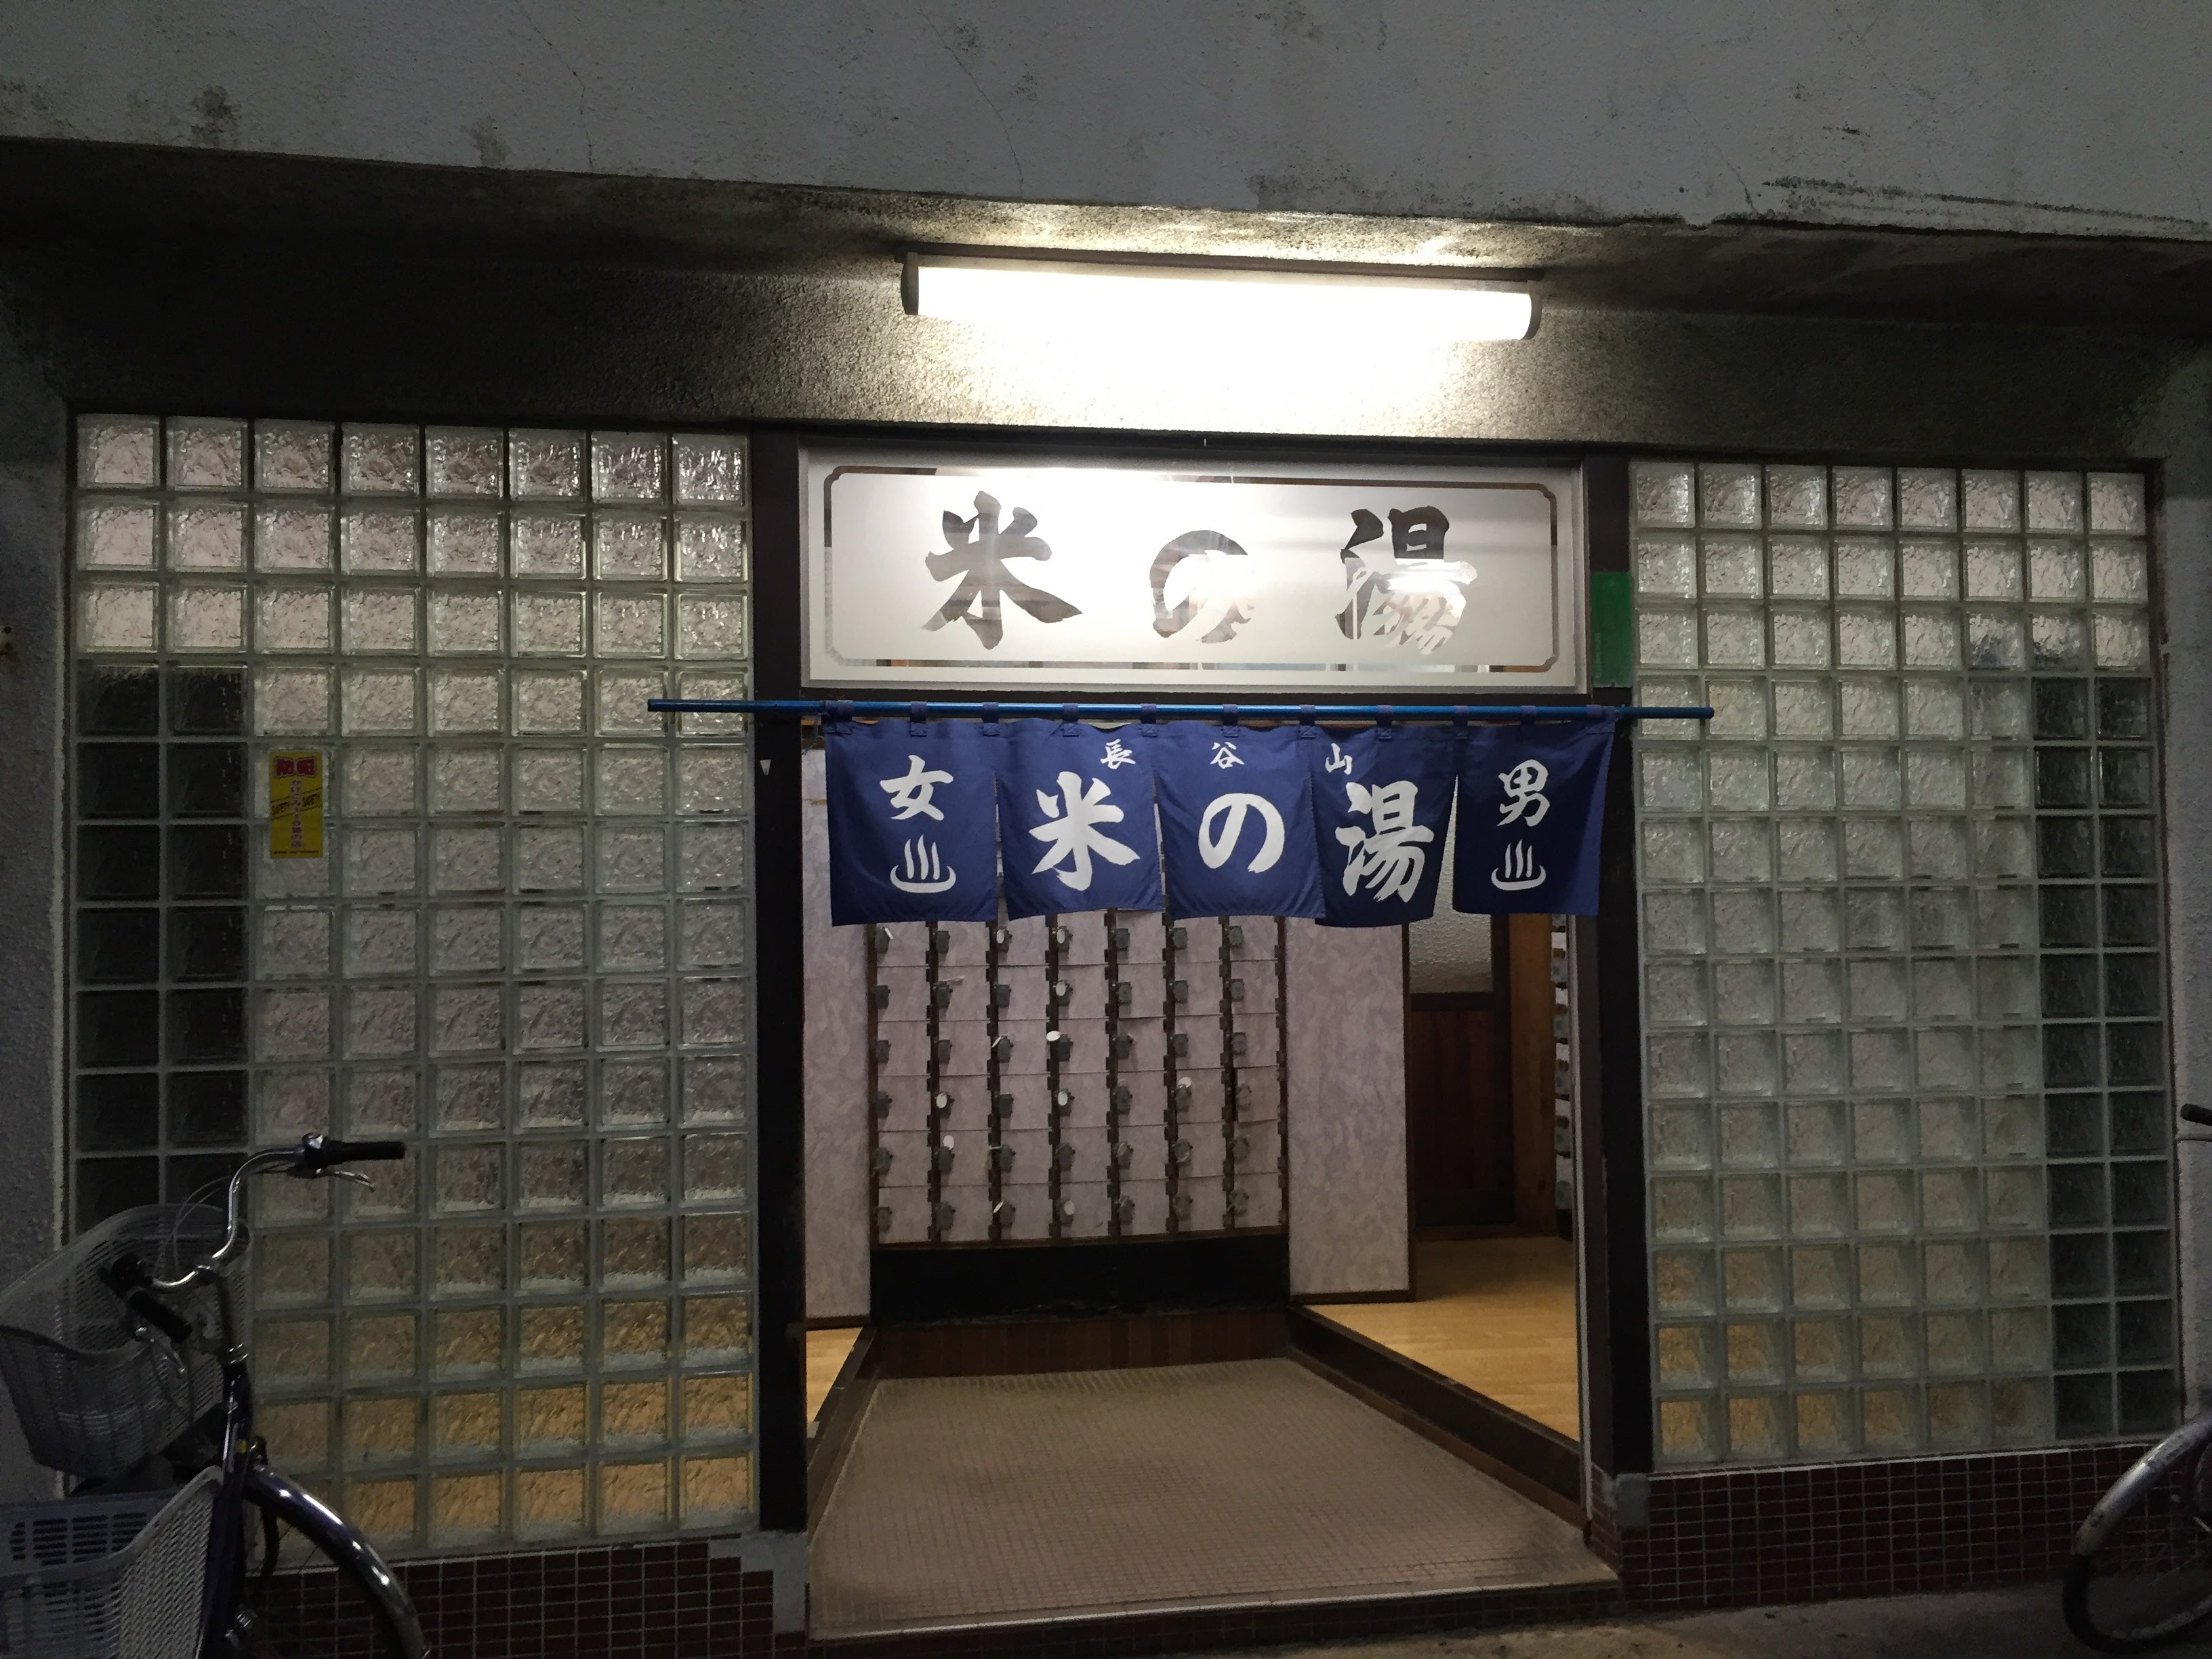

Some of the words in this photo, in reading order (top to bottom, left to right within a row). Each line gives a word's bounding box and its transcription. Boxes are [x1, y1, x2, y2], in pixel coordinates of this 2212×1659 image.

[922, 491, 1477, 655] 米の湯
[880, 754, 954, 821] 女
[1030, 771, 1435, 904] 米の湯
[1498, 758, 1551, 827] 男
